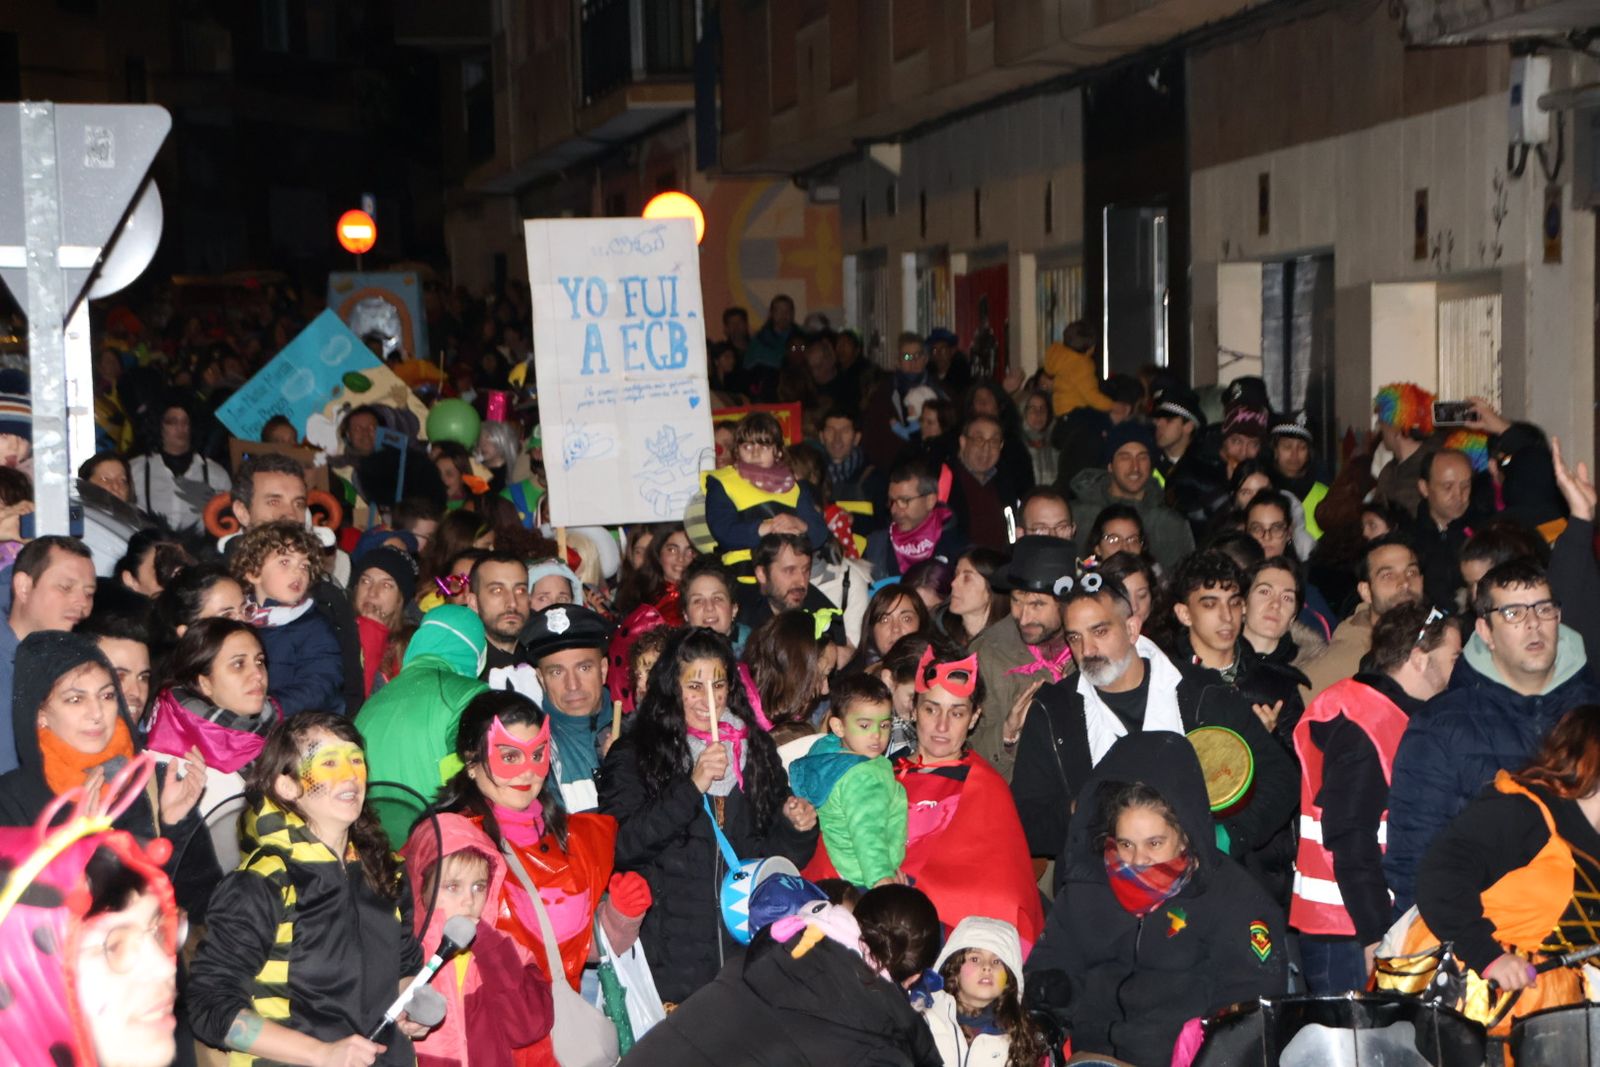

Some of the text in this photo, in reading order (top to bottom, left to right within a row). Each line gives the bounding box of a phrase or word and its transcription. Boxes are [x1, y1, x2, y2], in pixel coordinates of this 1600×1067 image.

[558, 275, 608, 320] YO
[580, 319, 689, 375] A EGB
